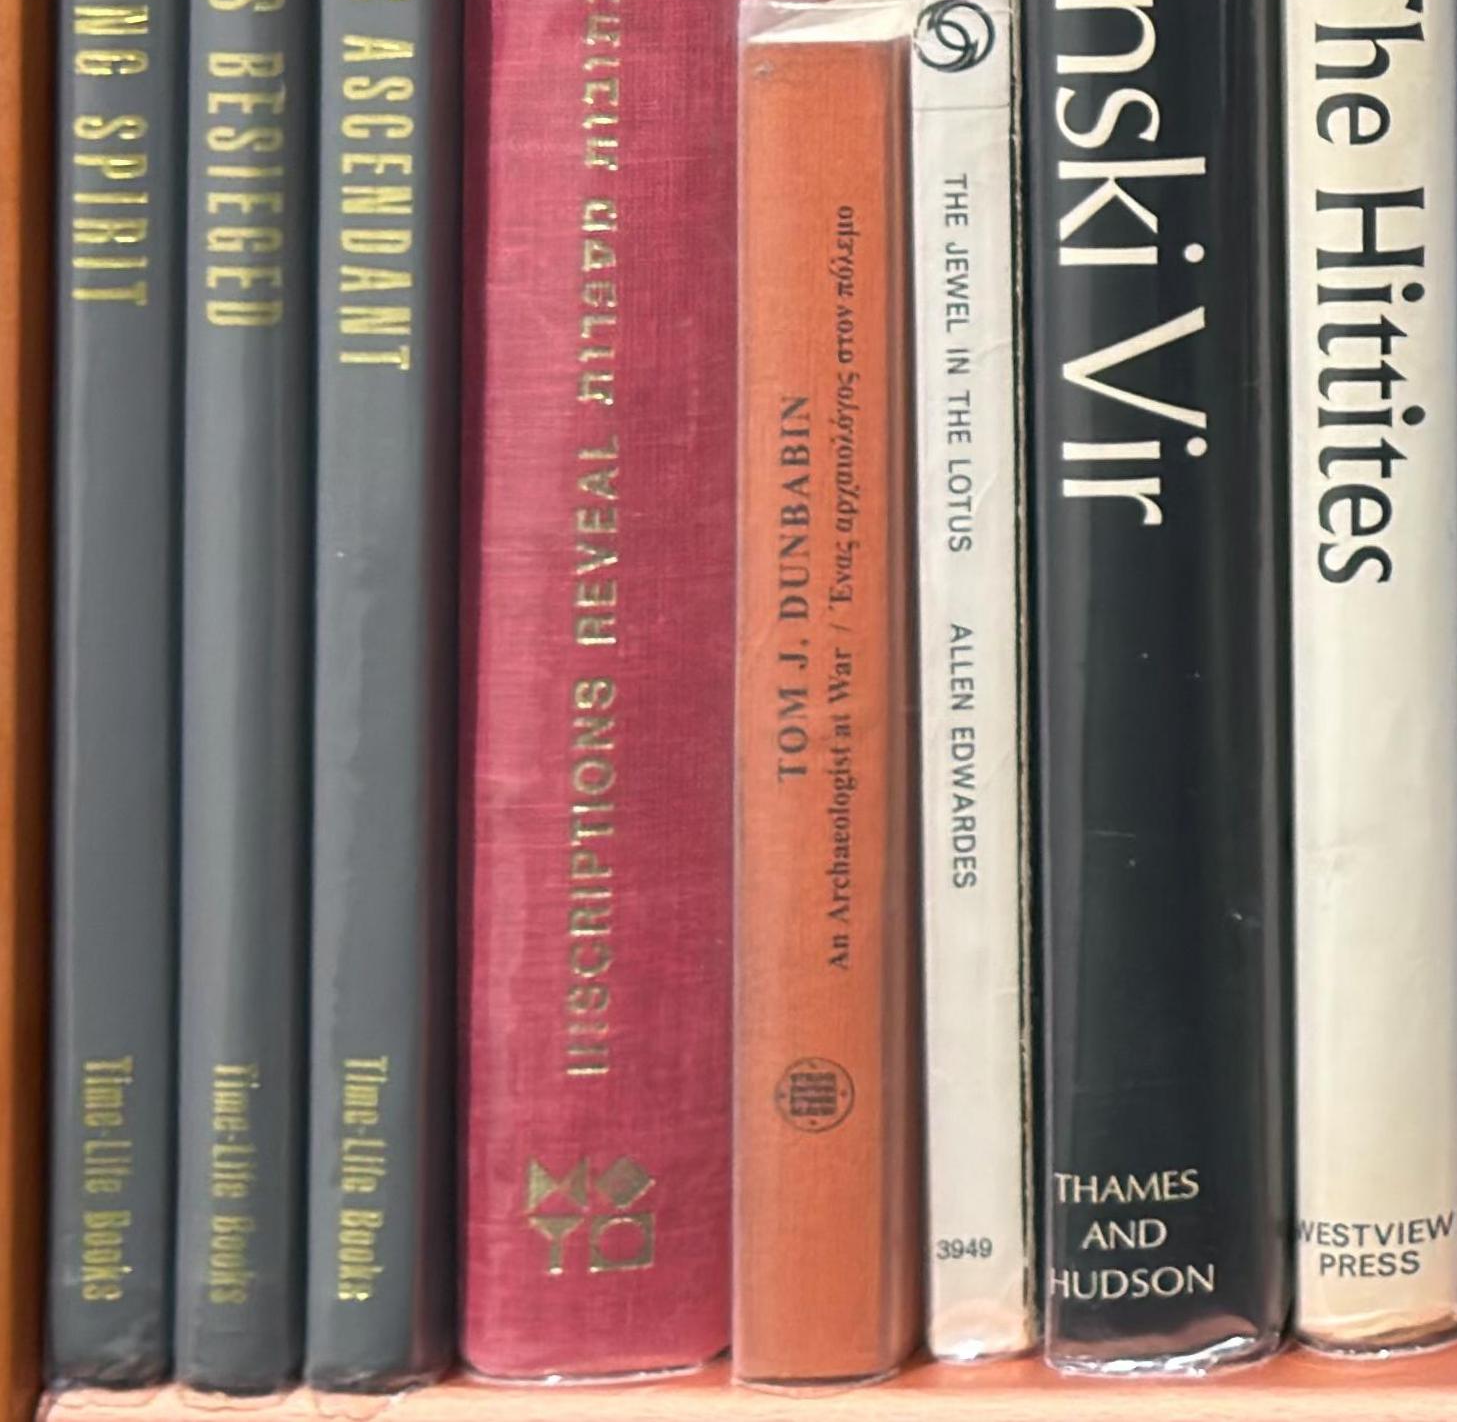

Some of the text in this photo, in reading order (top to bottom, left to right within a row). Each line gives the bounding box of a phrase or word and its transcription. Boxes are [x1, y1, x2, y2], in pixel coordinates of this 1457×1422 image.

[71, 114, 149, 306] SPIRIT
[204, 51, 286, 328] BESIEGED
[338, 33, 416, 371] ASCENDANT
[943, 173, 973, 553] THE JEWEL IN THE LOTUS
[1062, 305, 1208, 526] Vir
[1315, 186, 1426, 584] Hittites
[574, 433, 620, 647] REVEAL
[777, 393, 812, 784] TOM J. DUNBABIN
[949, 622, 977, 890] ALLEN EDWARDES
[80, 1209, 133, 1302] Books
[936, 1237, 994, 1261] 3949
[1050, 1263, 1215, 1302] HUDSON
[1054, 1168, 1200, 1204] THAMES
[1081, 1218, 1167, 1250] AND
[1299, 1211, 1455, 1247] WESTVIEW
[1319, 1251, 1421, 1278] PRESS
